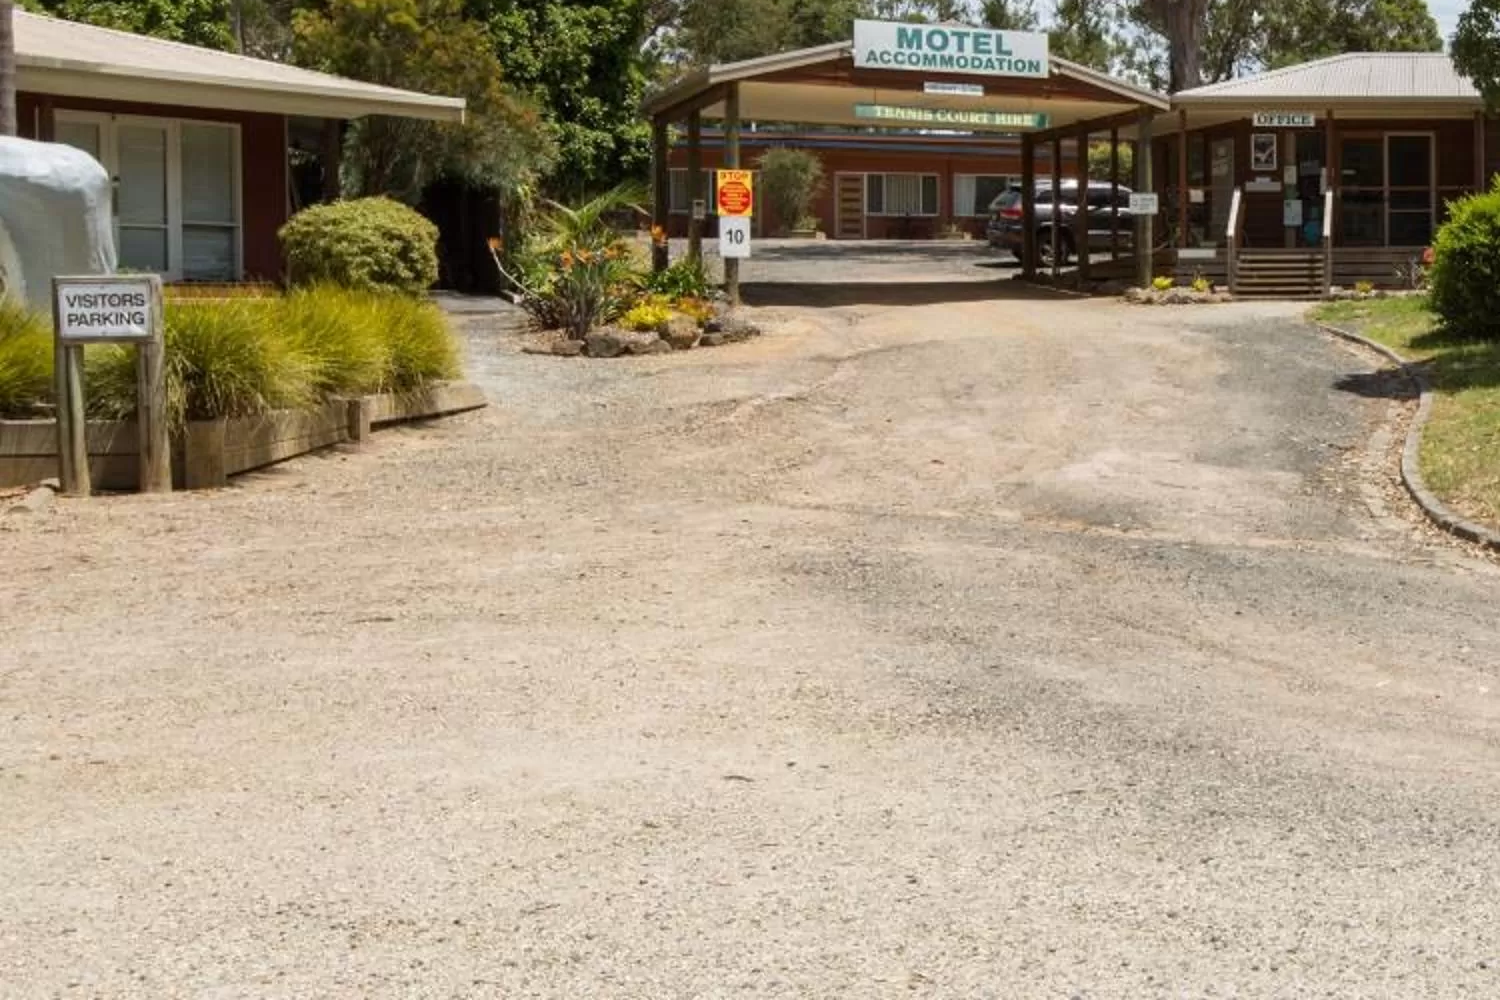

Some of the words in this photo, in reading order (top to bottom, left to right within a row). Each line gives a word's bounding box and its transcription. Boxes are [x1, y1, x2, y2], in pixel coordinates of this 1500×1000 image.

[897, 27, 1013, 56] MOTEL
[865, 50, 1041, 73] ACCOMMODATION
[876, 106, 933, 121] TENNIS
[936, 109, 989, 123] COURT
[994, 113, 1035, 126] HIRE
[1257, 114, 1312, 125] OFFICE
[725, 228, 745, 245] 10
[65, 293, 145, 308] VISITORS
[67, 311, 145, 326] PARKING
